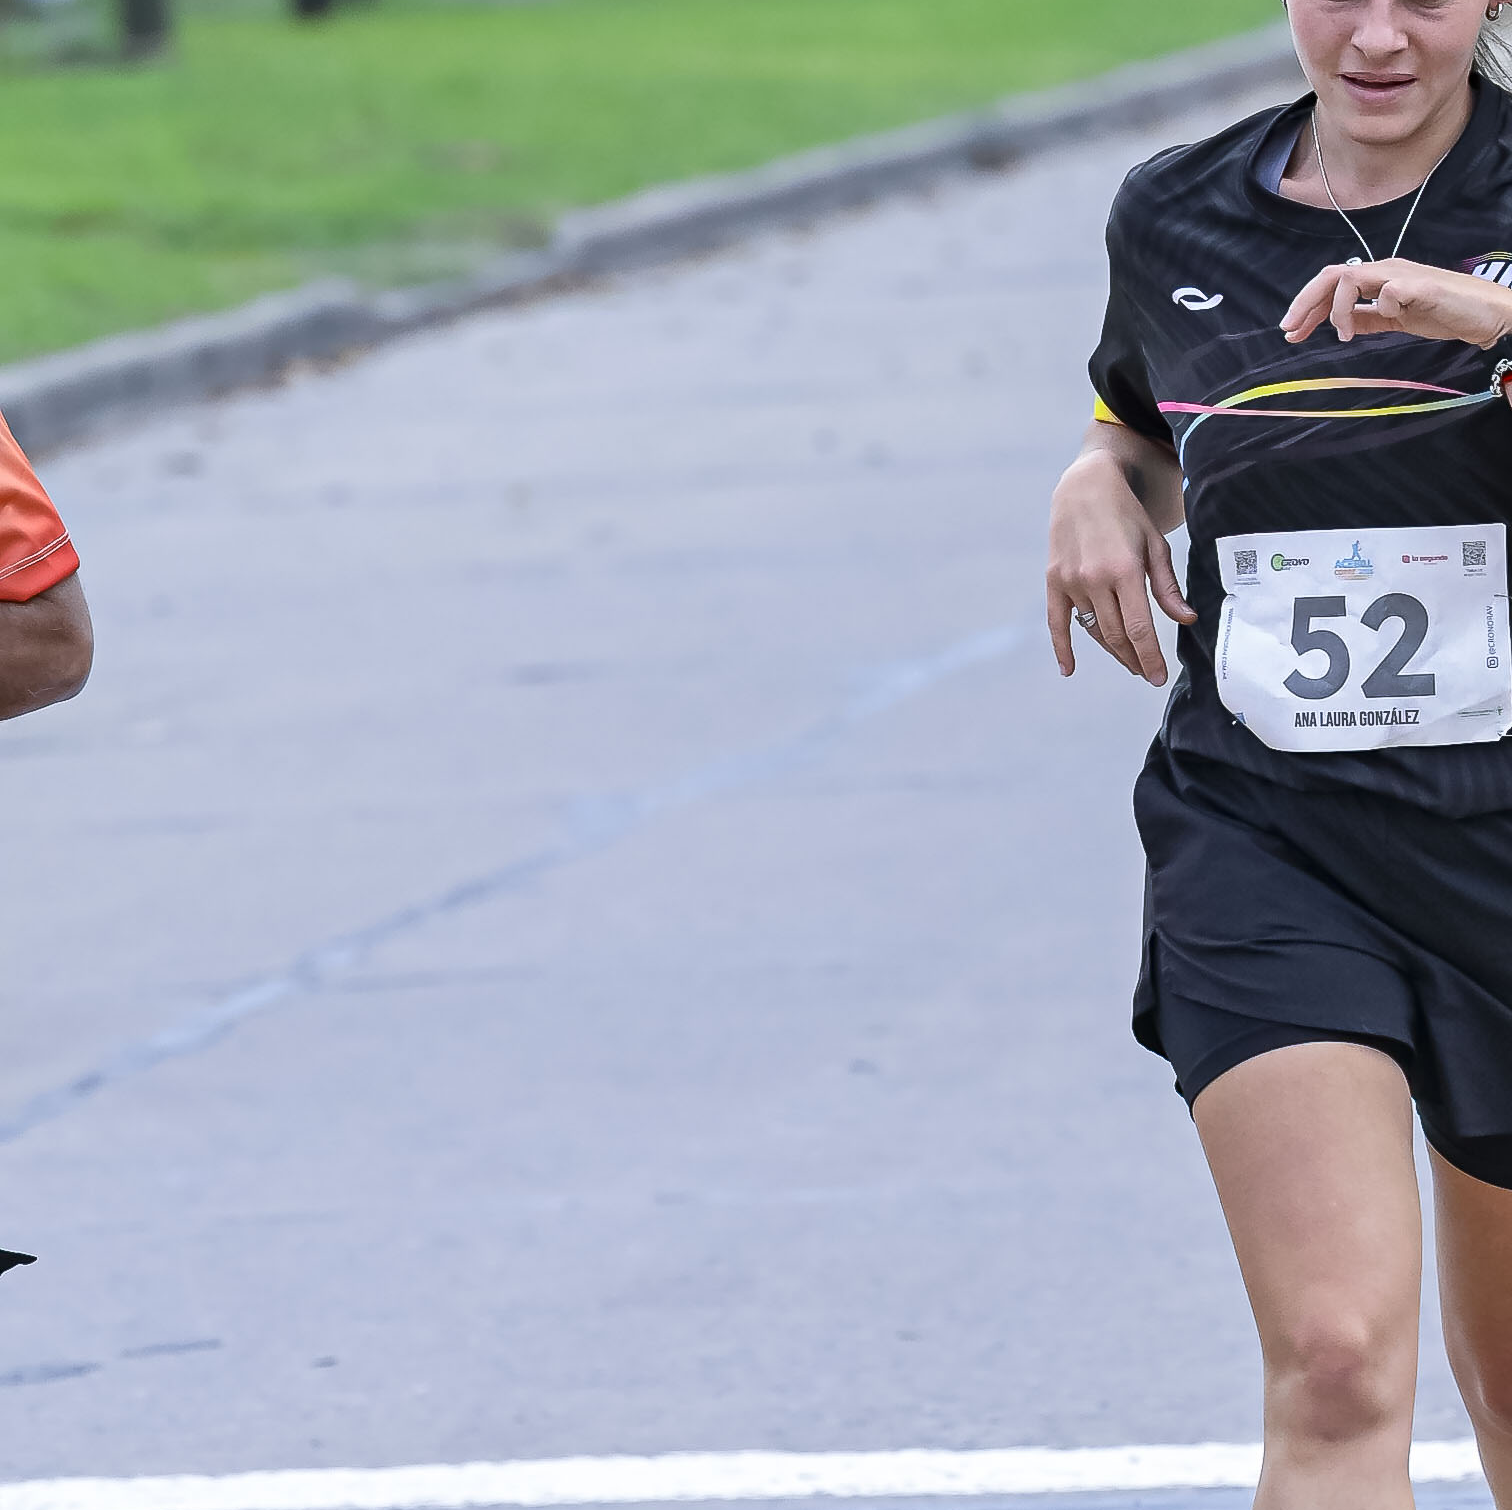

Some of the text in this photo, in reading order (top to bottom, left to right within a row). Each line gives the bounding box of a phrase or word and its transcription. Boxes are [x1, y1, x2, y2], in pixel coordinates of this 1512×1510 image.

[1283, 593, 1436, 700] 52
[1294, 707, 1420, 728] ANA LAURA GONZÁLEZ
